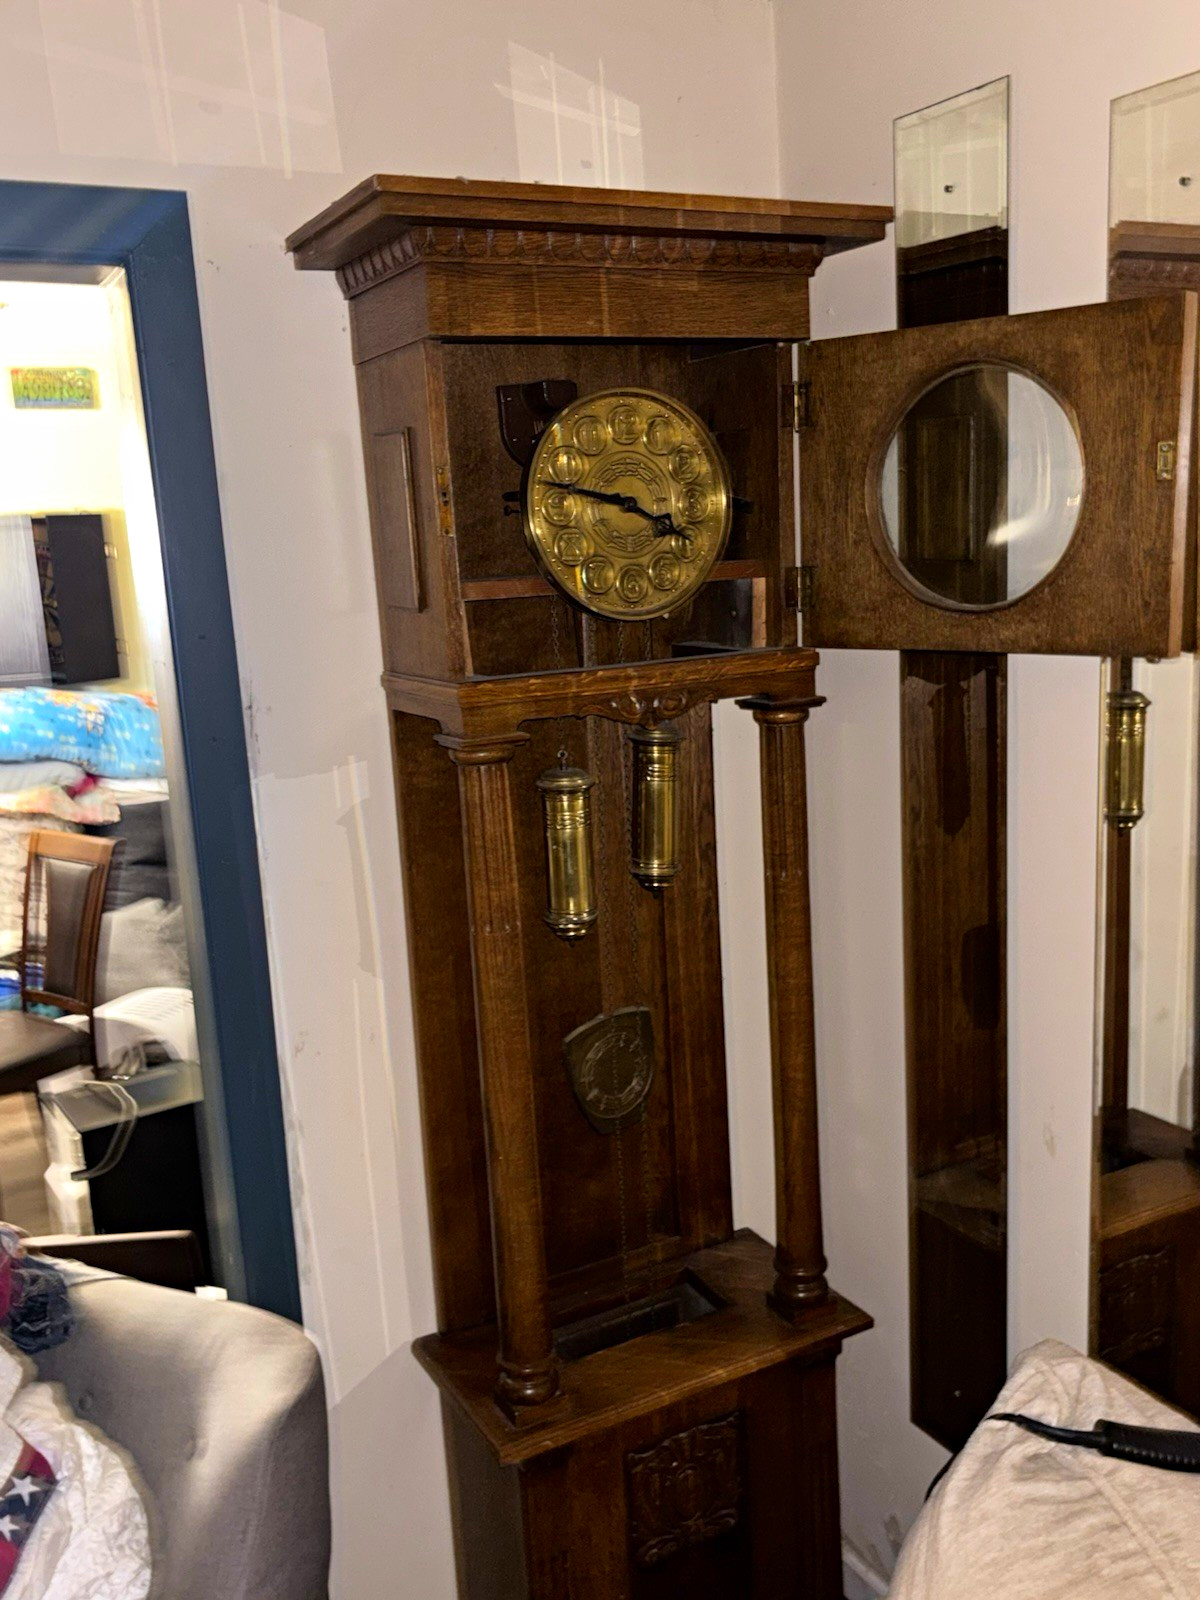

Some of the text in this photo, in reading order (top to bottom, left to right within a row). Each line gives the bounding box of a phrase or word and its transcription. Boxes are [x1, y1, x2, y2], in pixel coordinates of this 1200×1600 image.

[677, 452, 694, 480] 2
[685, 488, 701, 518] 3
[560, 534, 581, 561] 8
[588, 562, 606, 589] 7
[624, 573, 641, 599] 6
[656, 560, 671, 587] 5
